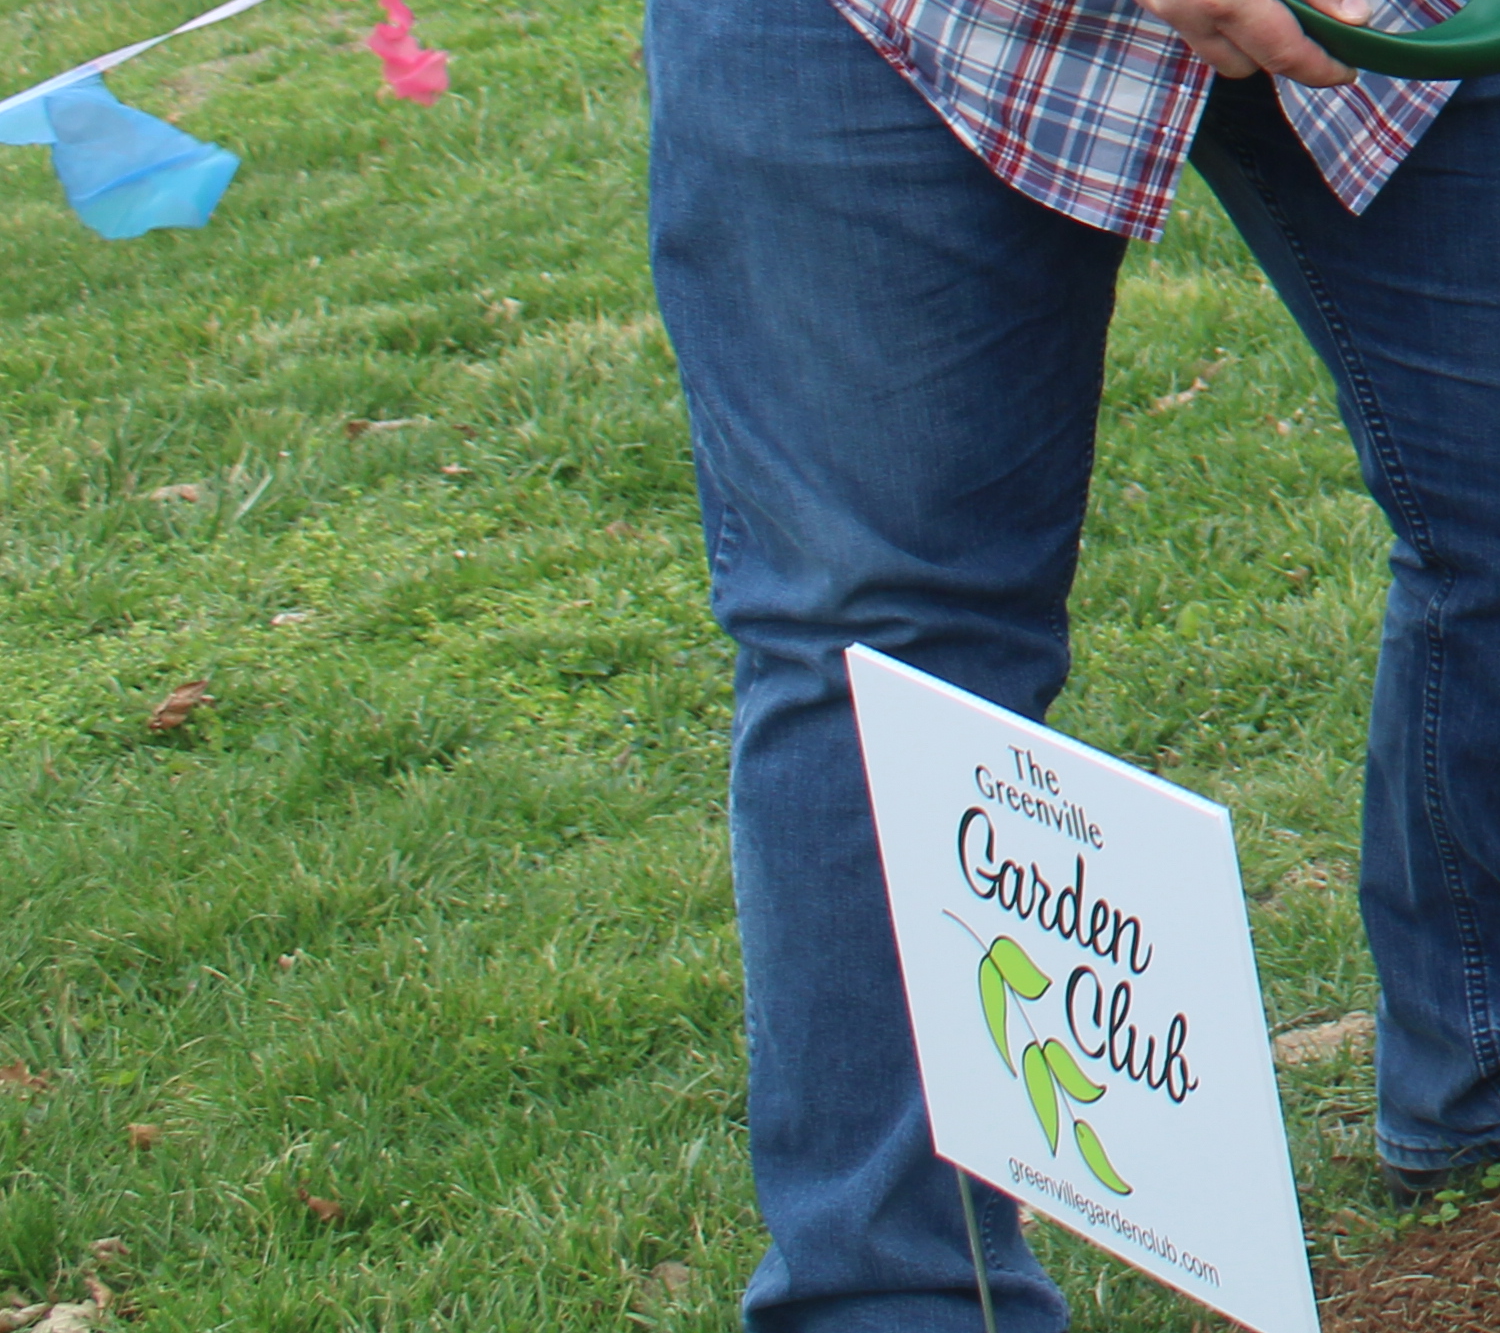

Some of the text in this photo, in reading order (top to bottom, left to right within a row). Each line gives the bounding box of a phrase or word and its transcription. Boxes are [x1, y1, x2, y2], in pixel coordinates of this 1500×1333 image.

[974, 764, 1105, 850] Greenville
[1007, 743, 1060, 796] The
[957, 805, 1153, 975] Garden
[1066, 964, 1200, 1104] Club
[1008, 1157, 1222, 1287] greenvillegardenclub.com
